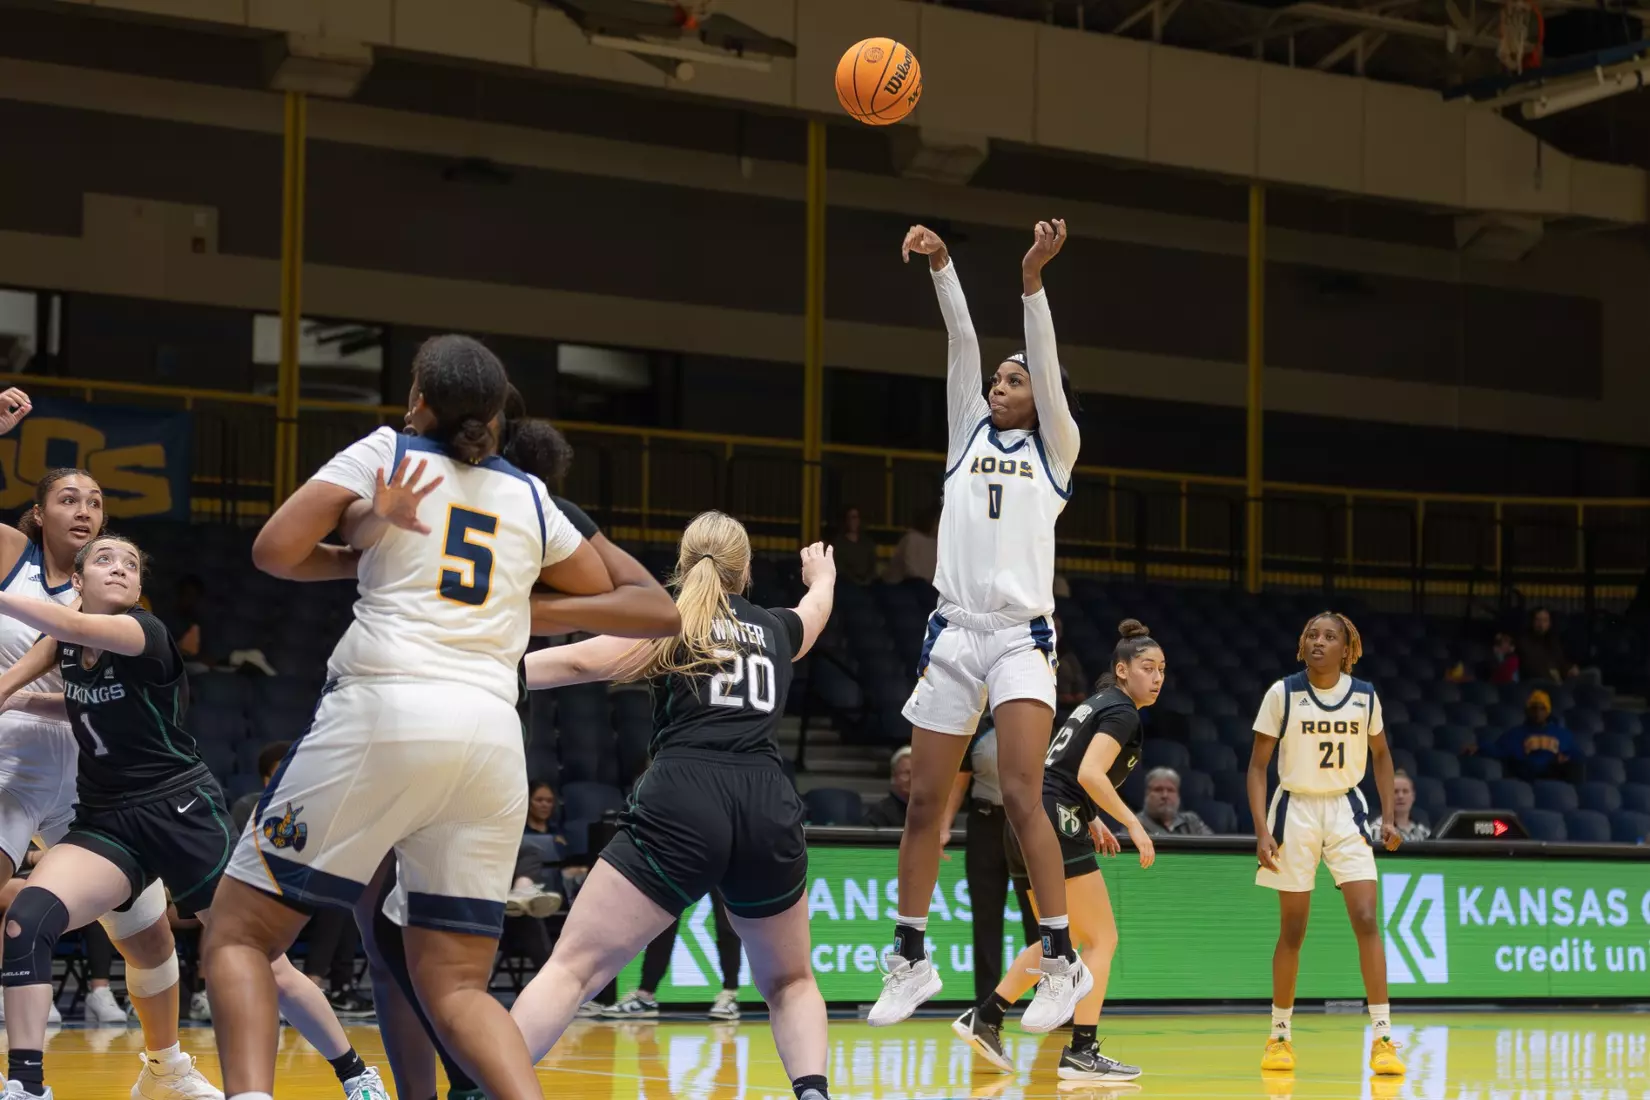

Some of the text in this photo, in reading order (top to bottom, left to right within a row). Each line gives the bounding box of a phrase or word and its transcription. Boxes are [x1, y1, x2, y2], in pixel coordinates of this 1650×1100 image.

[884, 49, 914, 95] Wilson
[988, 483, 1003, 520] 0
[436, 502, 500, 609] 5
[710, 648, 776, 714] 20
[80, 713, 109, 758] 1
[1301, 720, 1360, 735] ROOS
[1319, 741, 1345, 769] 21
[808, 877, 974, 922] ANSAS
[1458, 886, 1629, 927] KANSAS
[1495, 938, 1650, 973] credit un
